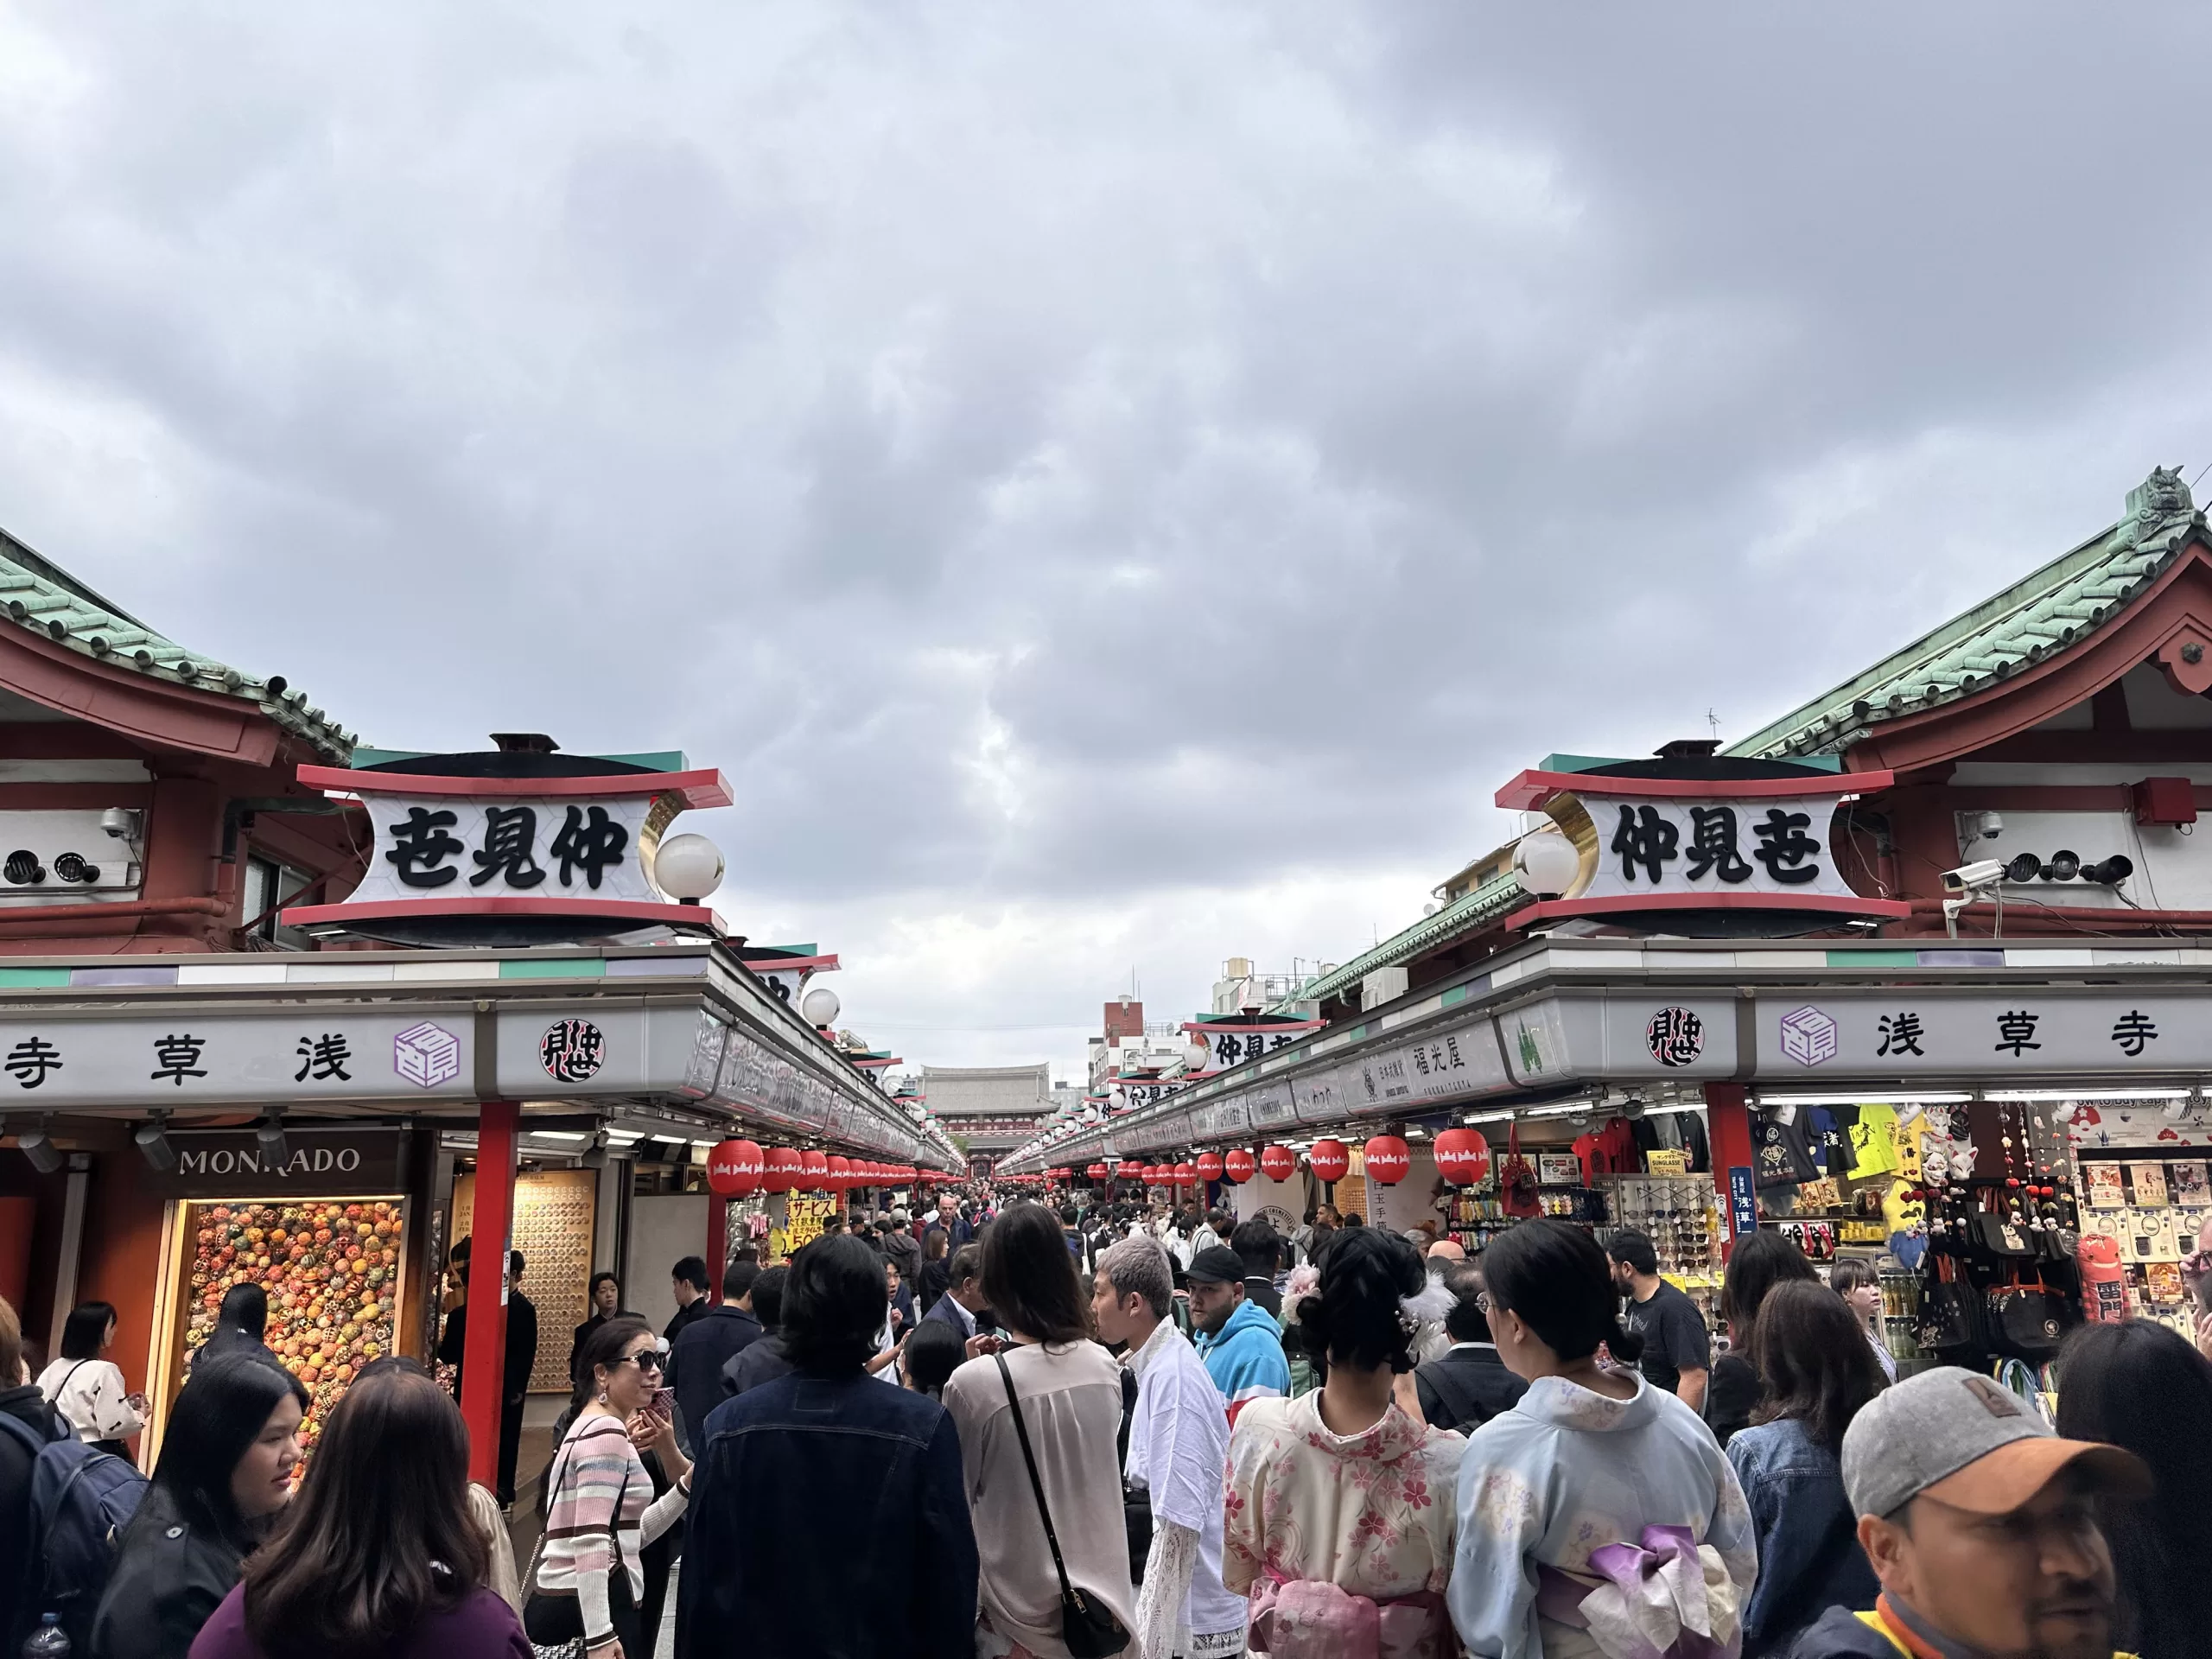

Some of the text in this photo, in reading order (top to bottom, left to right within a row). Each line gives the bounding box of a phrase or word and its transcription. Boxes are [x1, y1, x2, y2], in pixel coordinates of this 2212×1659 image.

[1611, 804, 1821, 884] 仲見世
[1876, 1009, 2158, 1057] 浅草寺
[1414, 1037, 1465, 1076] 福光屋
[2096, 1281, 2123, 1321] 雷門
